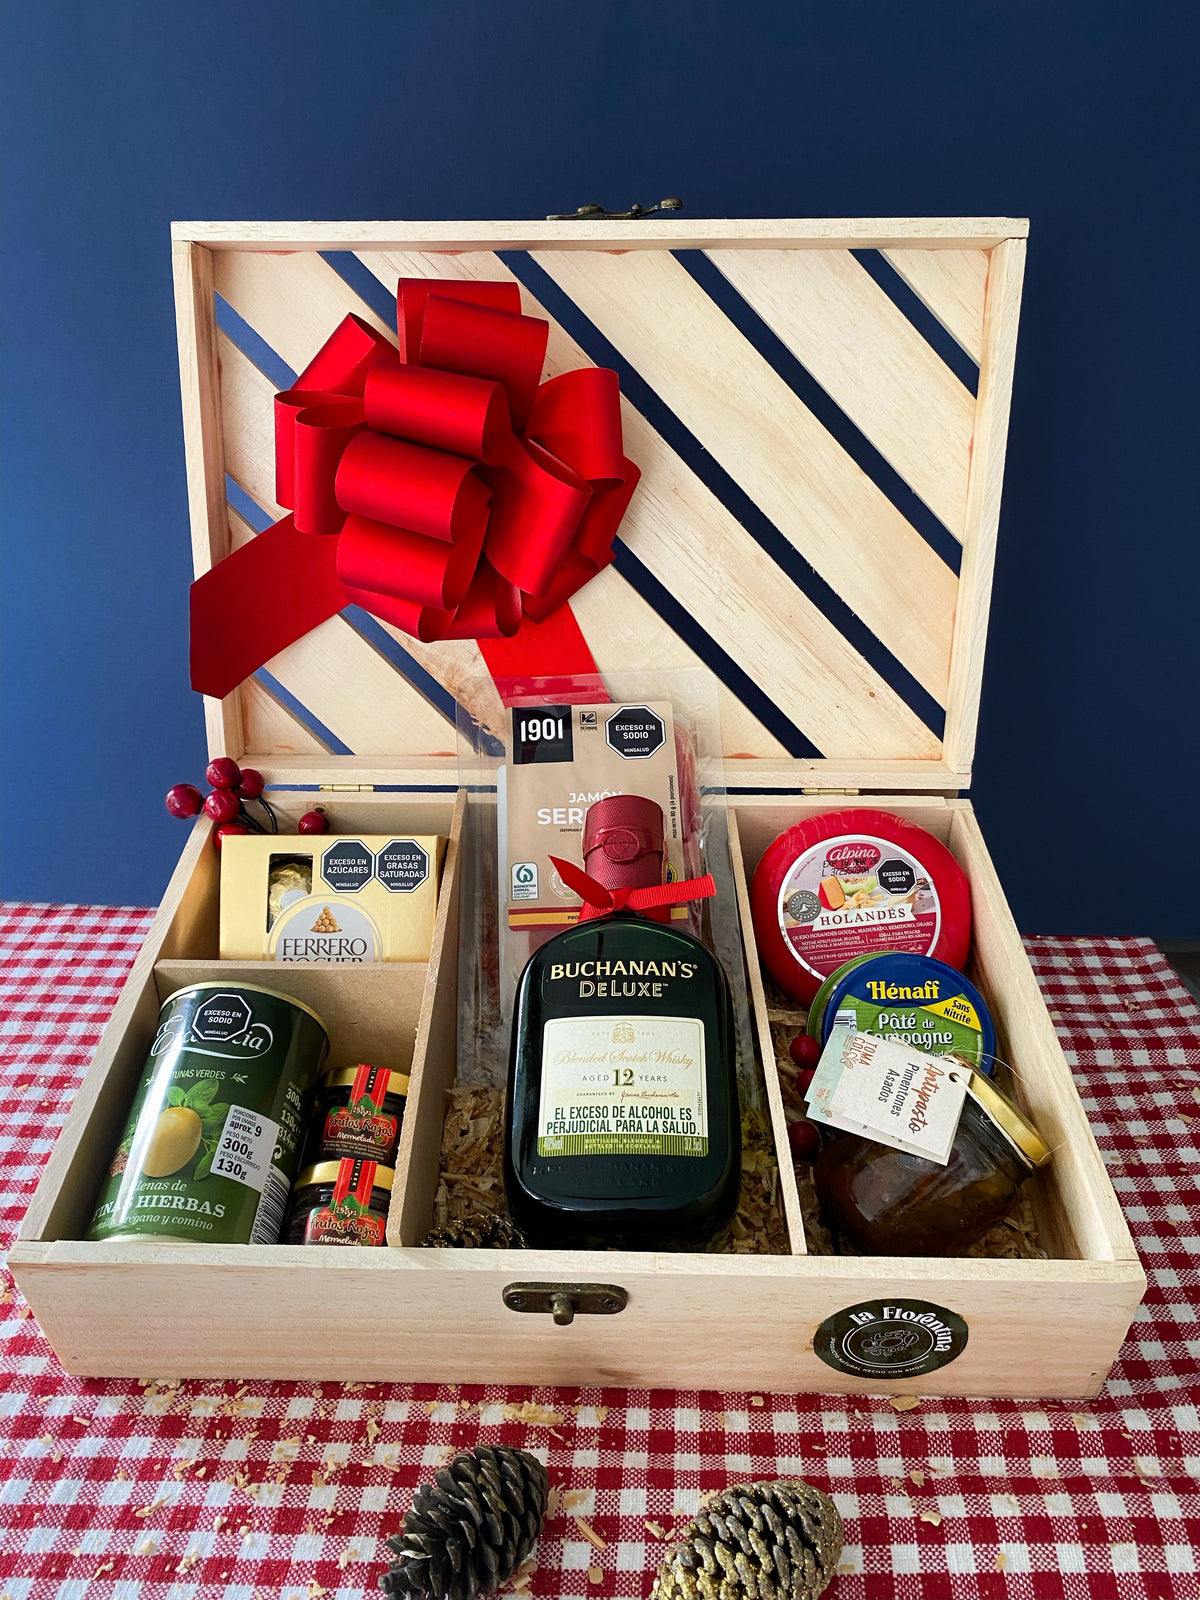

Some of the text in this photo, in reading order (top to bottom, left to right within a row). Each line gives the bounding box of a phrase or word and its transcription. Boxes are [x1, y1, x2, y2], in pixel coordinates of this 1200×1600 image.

[520, 718, 564, 742] 1901
[615, 724, 644, 732] EXCESO
[622, 732, 648, 740] SODIO
[569, 788, 622, 803] JAMÓ
[330, 858, 356, 866] EXCESO
[384, 854, 410, 862] EXCESO
[822, 860, 837, 868] EXP
[853, 858, 867, 866] MAR
[829, 846, 877, 863] alpina
[326, 864, 369, 874] AZÚCARES
[380, 870, 425, 879] SATURADAS
[386, 862, 419, 870] GRASAS
[820, 908, 906, 927] HOLANDÉS
[282, 938, 368, 957] FERRERO
[550, 960, 695, 980] BUCHANAN'S
[866, 980, 940, 1000] Hénaff
[943, 1006, 971, 1024] Nitrite
[952, 1000, 970, 1013] Sans
[208, 1016, 233, 1024] SODIO
[878, 1012, 935, 1030] Pâté de
[850, 1036, 866, 1053] COL
[553, 1048, 695, 1070] Blended Scotch Whisky
[858, 1041, 878, 1066] TOMA
[172, 1068, 226, 1080] TUNAS VERDES
[582, 1068, 668, 1086] AGED 12 YEARS
[878, 1068, 900, 1104] Asados
[890, 1062, 920, 1117] Pimentones
[908, 1062, 946, 1134] Antipasto
[232, 1114, 241, 1122] POR
[234, 1108, 257, 1121] PORCIONES
[554, 1106, 692, 1121] EL EXCESO DE ALCOHOL ES
[230, 1120, 262, 1138] aprox. 9
[362, 1118, 394, 1138] Rojos
[546, 1120, 700, 1136] PERJUDICIAL PARA LA SALUD.
[226, 1130, 253, 1144] PESO NETO
[336, 1130, 376, 1144] Mermelada
[222, 1138, 254, 1160] 300g
[220, 1150, 234, 1160] PESO
[234, 1156, 260, 1170] ESCURRIDO
[216, 1158, 248, 1180] 130g
[136, 1180, 188, 1192] lenas de
[93, 1195, 226, 1222] FINA HIERBAS
[126, 1213, 160, 1225] régano
[161, 1215, 170, 1225] y
[172, 1215, 214, 1231] comino
[347, 1218, 380, 1240] Rojos
[318, 1234, 362, 1246] Mermelada
[882, 1306, 954, 1352] Florentina
[838, 1358, 860, 1371] NATURAL
